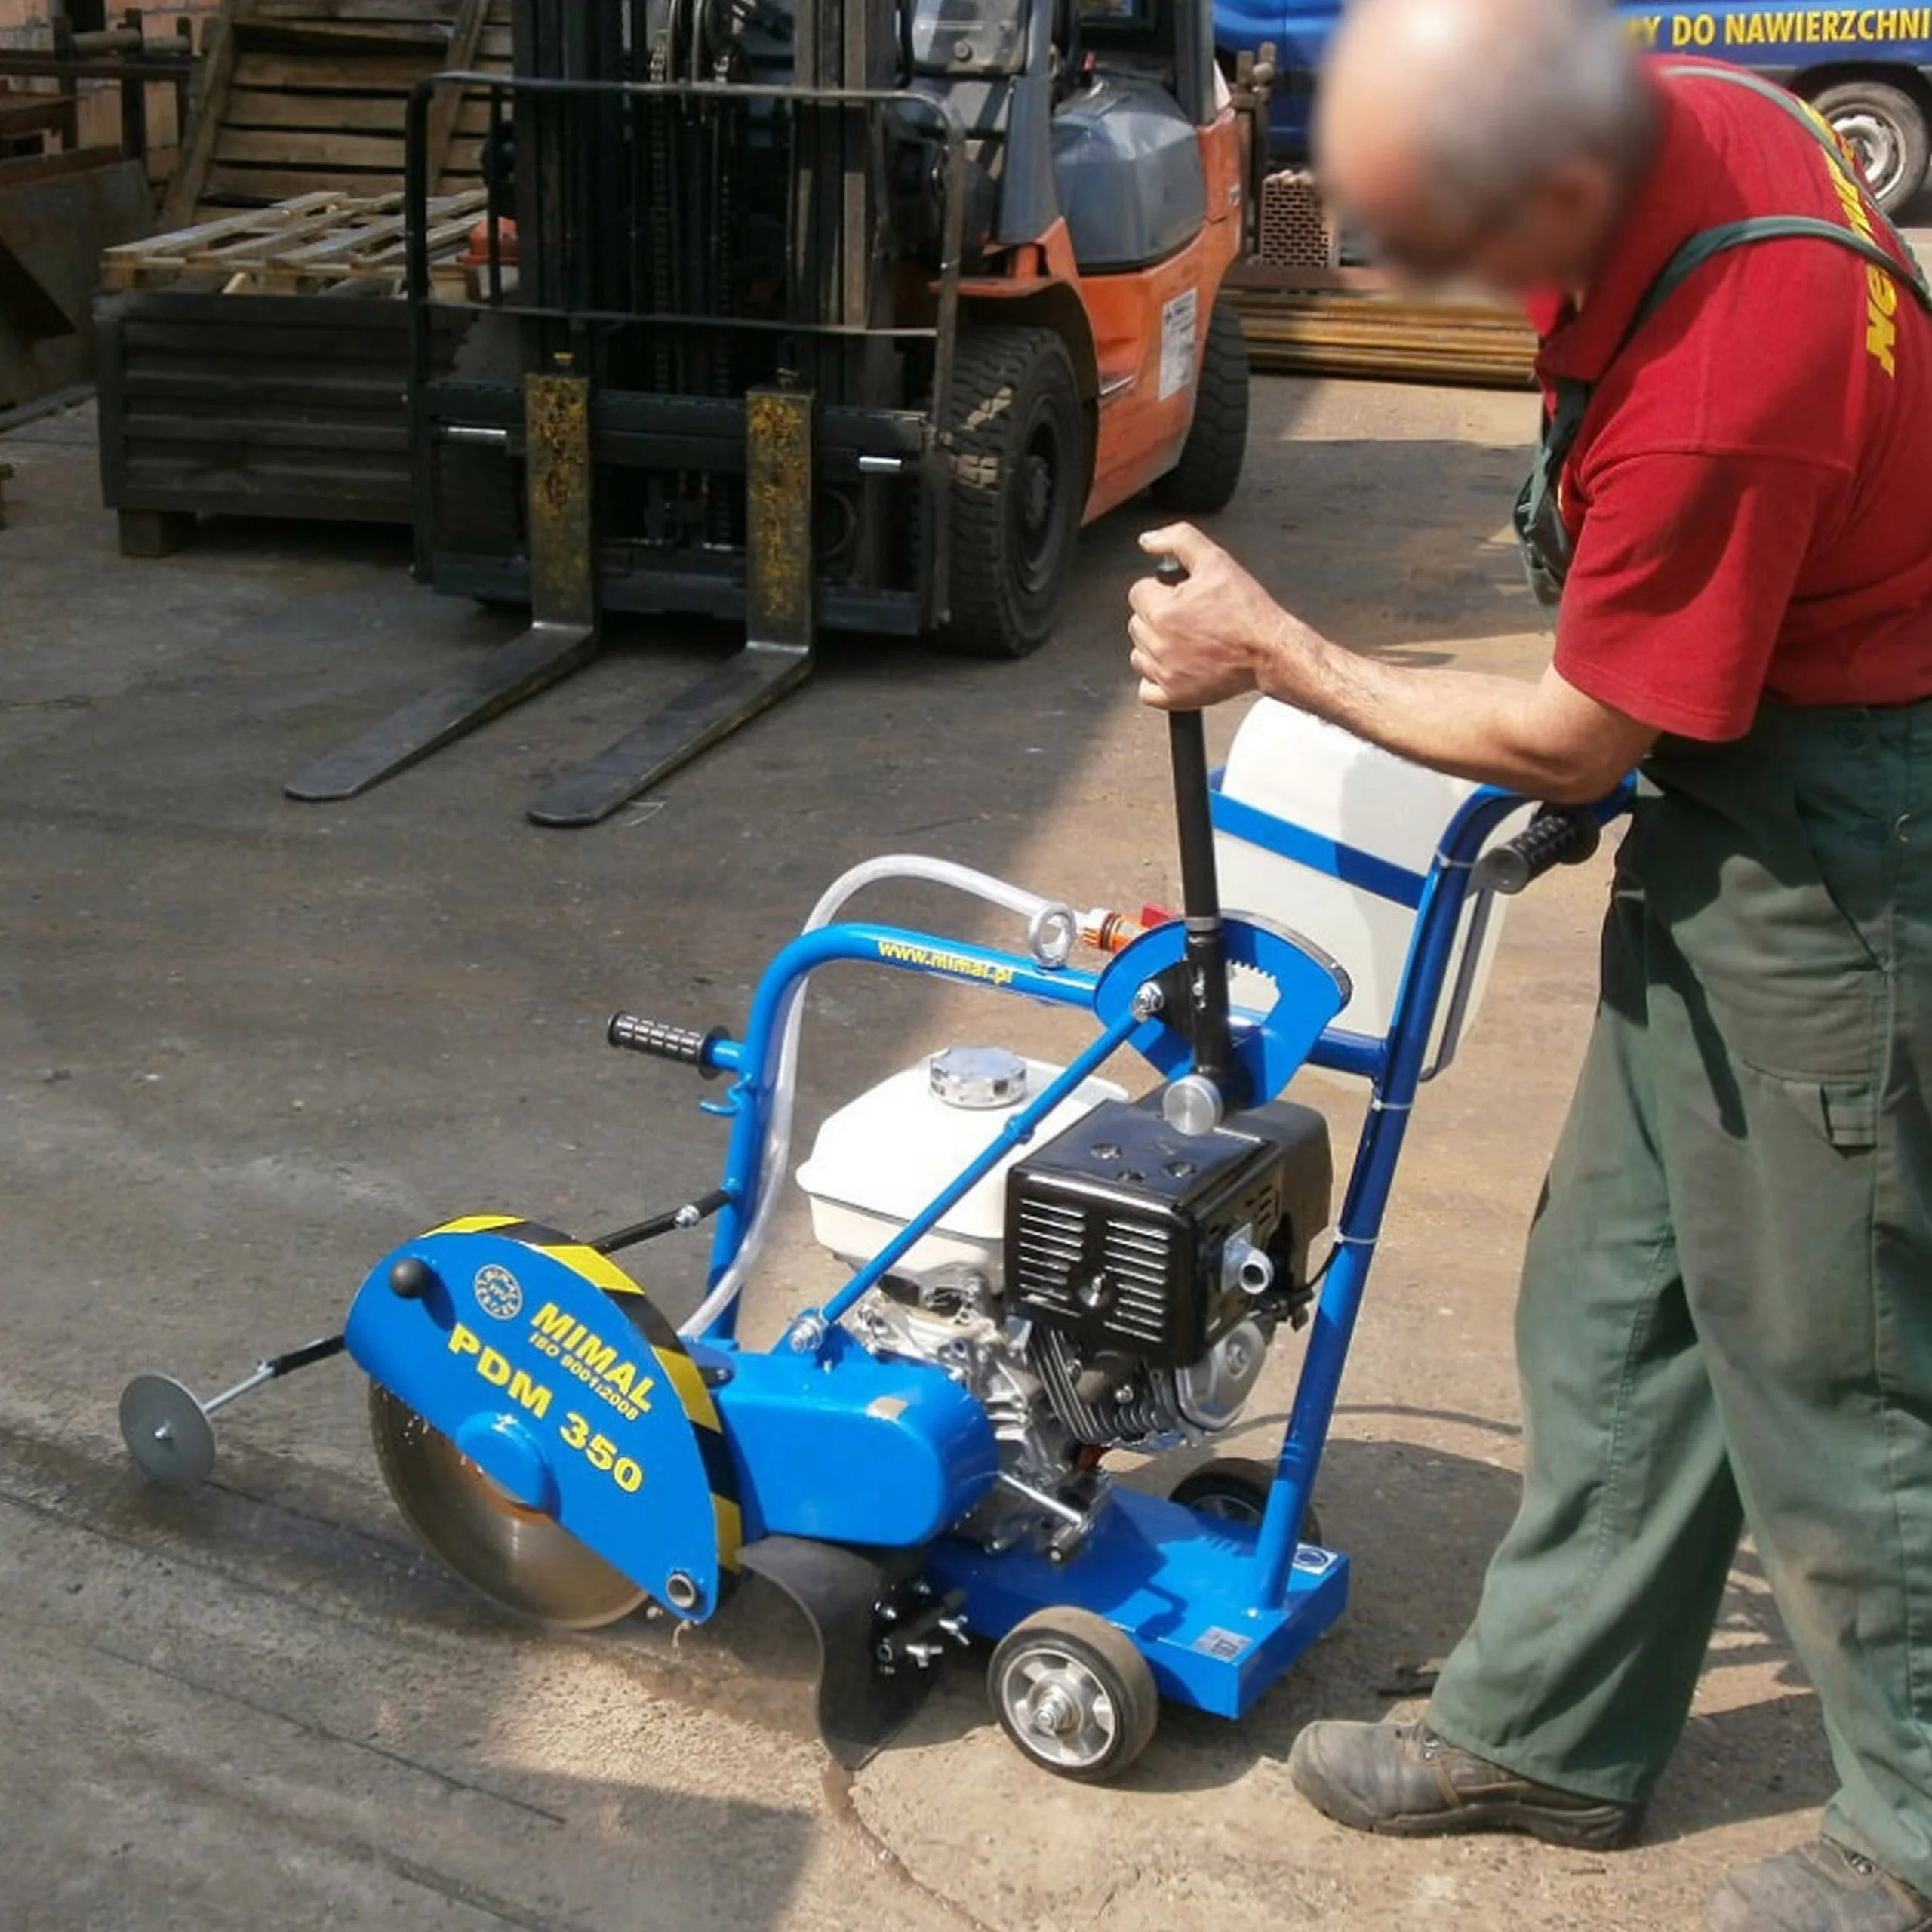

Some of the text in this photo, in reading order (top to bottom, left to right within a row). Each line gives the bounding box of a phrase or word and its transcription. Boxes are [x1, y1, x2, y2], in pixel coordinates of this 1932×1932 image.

[1672, 14, 1715, 46] DO
[1725, 8, 1931, 45] NAWIERZCHNI
[878, 940, 1013, 984] www.mimal.pl
[528, 1331, 560, 1358] ISO
[531, 1302, 654, 1413] MIMAL
[448, 1322, 644, 1494] PDM 350
